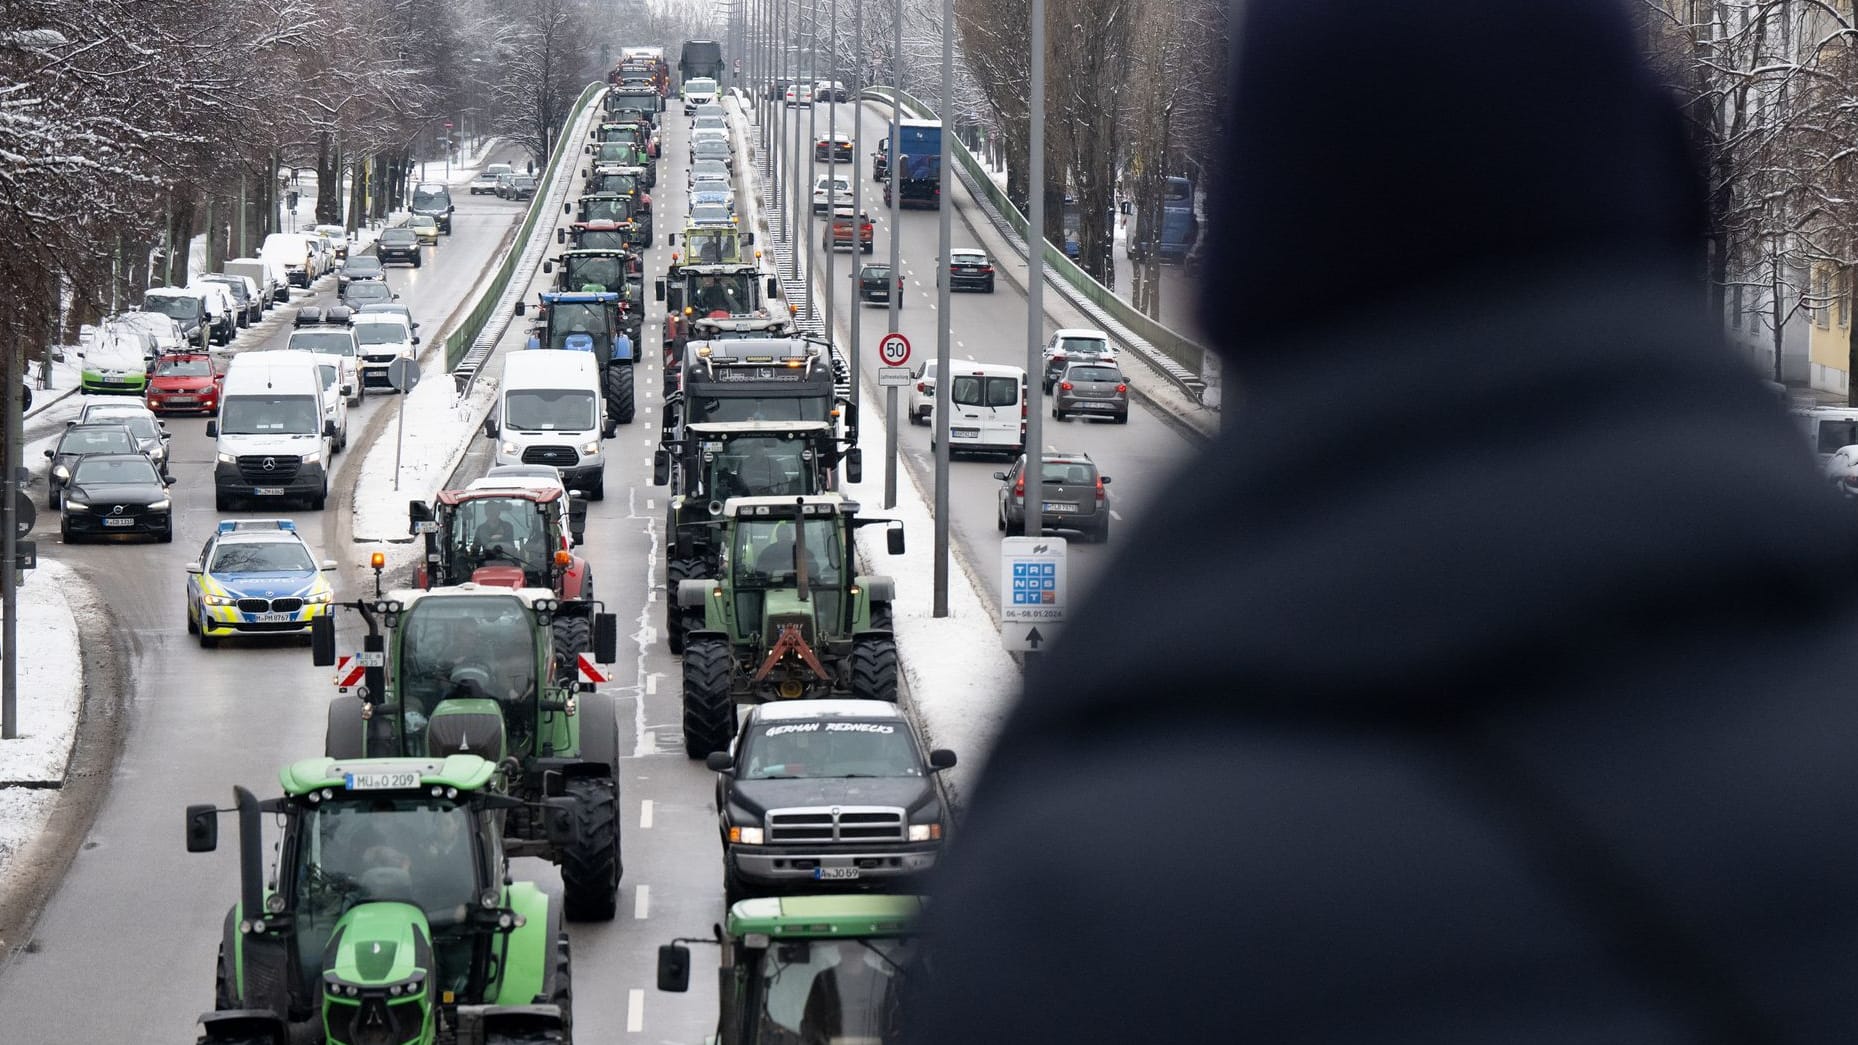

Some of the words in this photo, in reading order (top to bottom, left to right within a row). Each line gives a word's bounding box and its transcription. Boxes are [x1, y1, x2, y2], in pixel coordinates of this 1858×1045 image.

[887, 342, 904, 357] 50
[765, 722, 819, 737] GERMAN
[825, 722, 894, 734] REDNECKS
[392, 774, 415, 786] 209
